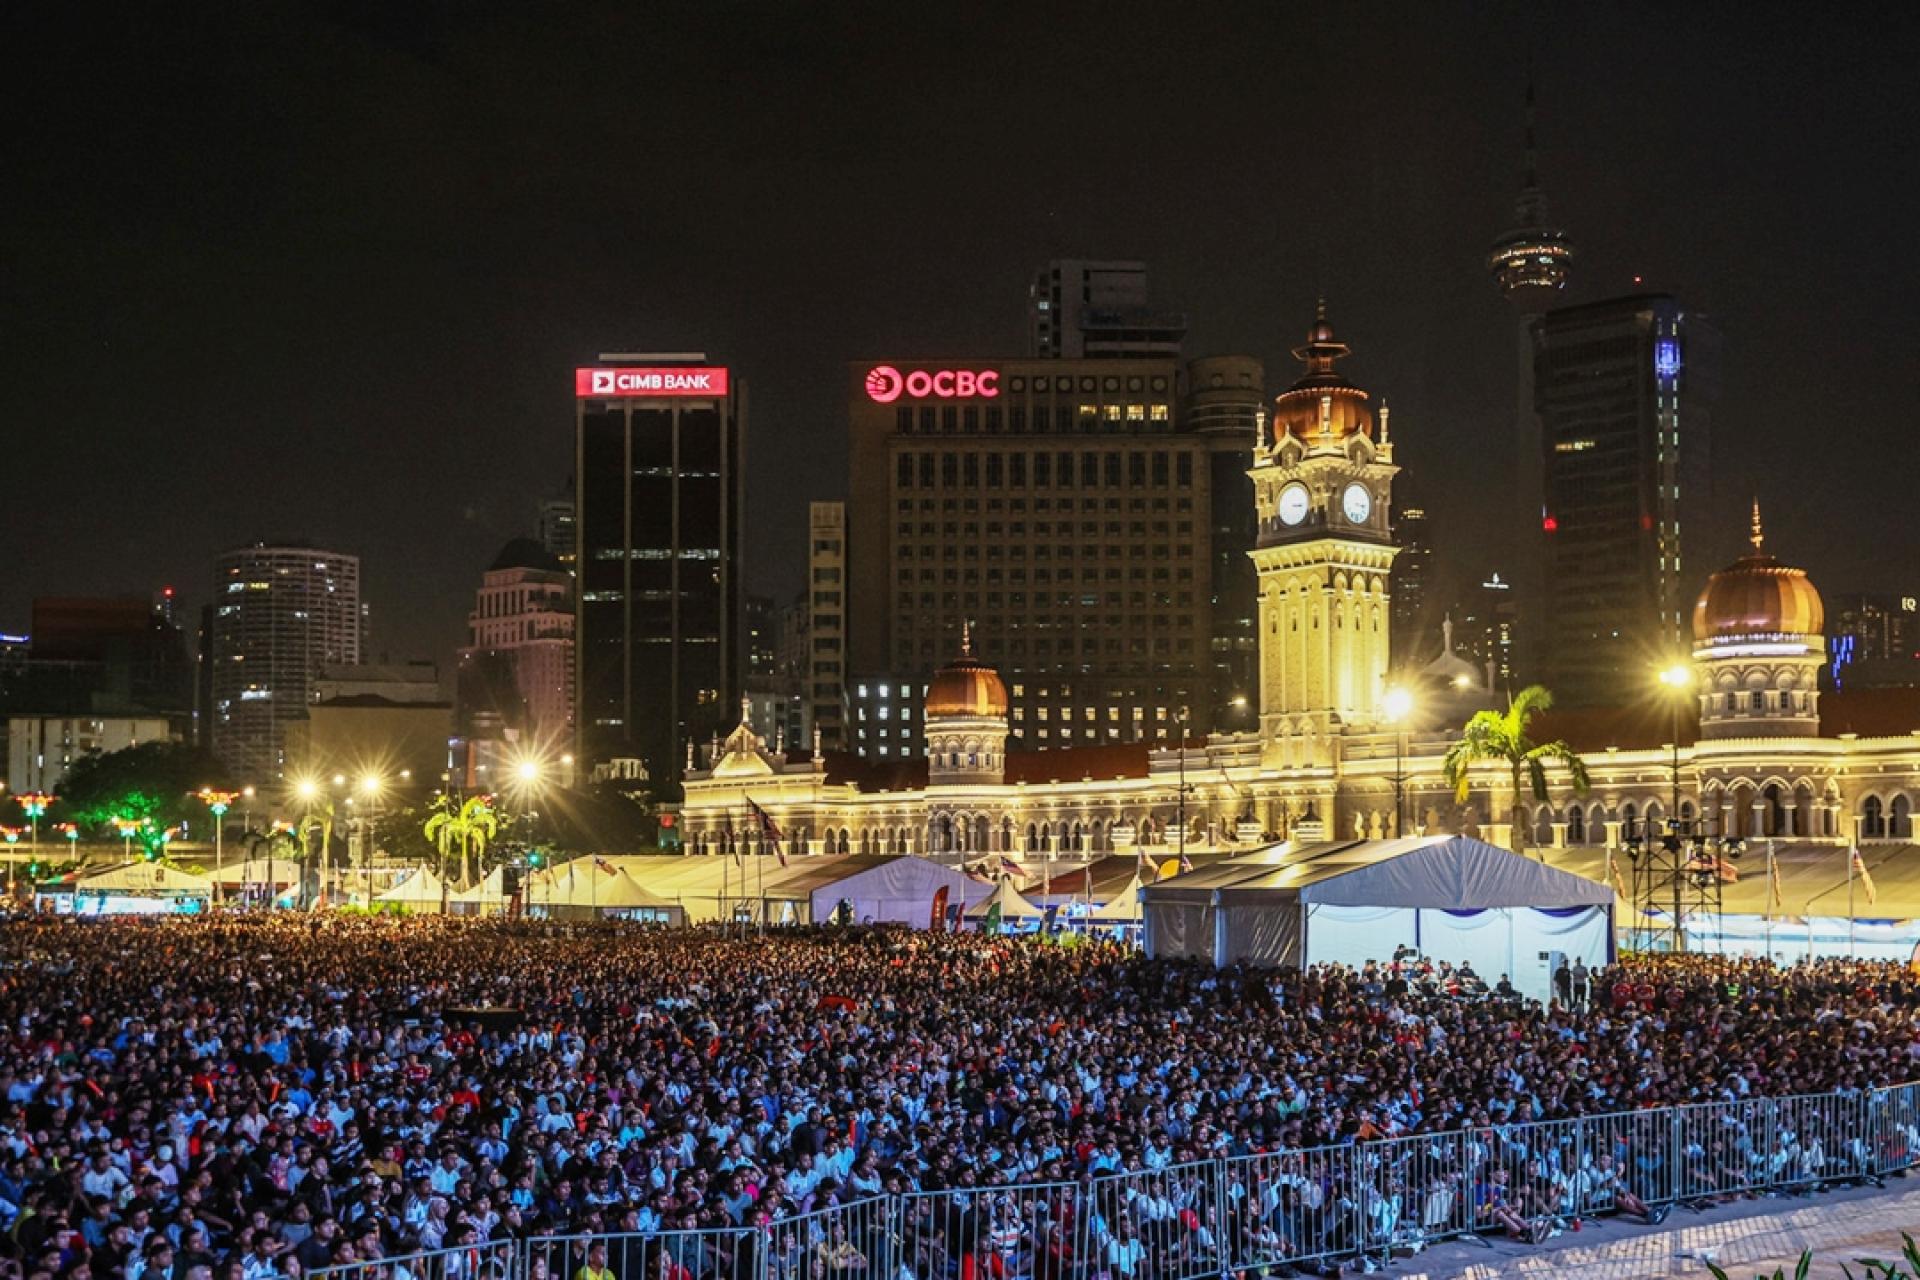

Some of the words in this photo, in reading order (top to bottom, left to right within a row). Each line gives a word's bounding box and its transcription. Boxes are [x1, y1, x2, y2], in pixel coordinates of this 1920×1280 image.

[617, 374, 662, 388] CIMB
[664, 374, 710, 389] BANK
[906, 370, 999, 397] OCBC
